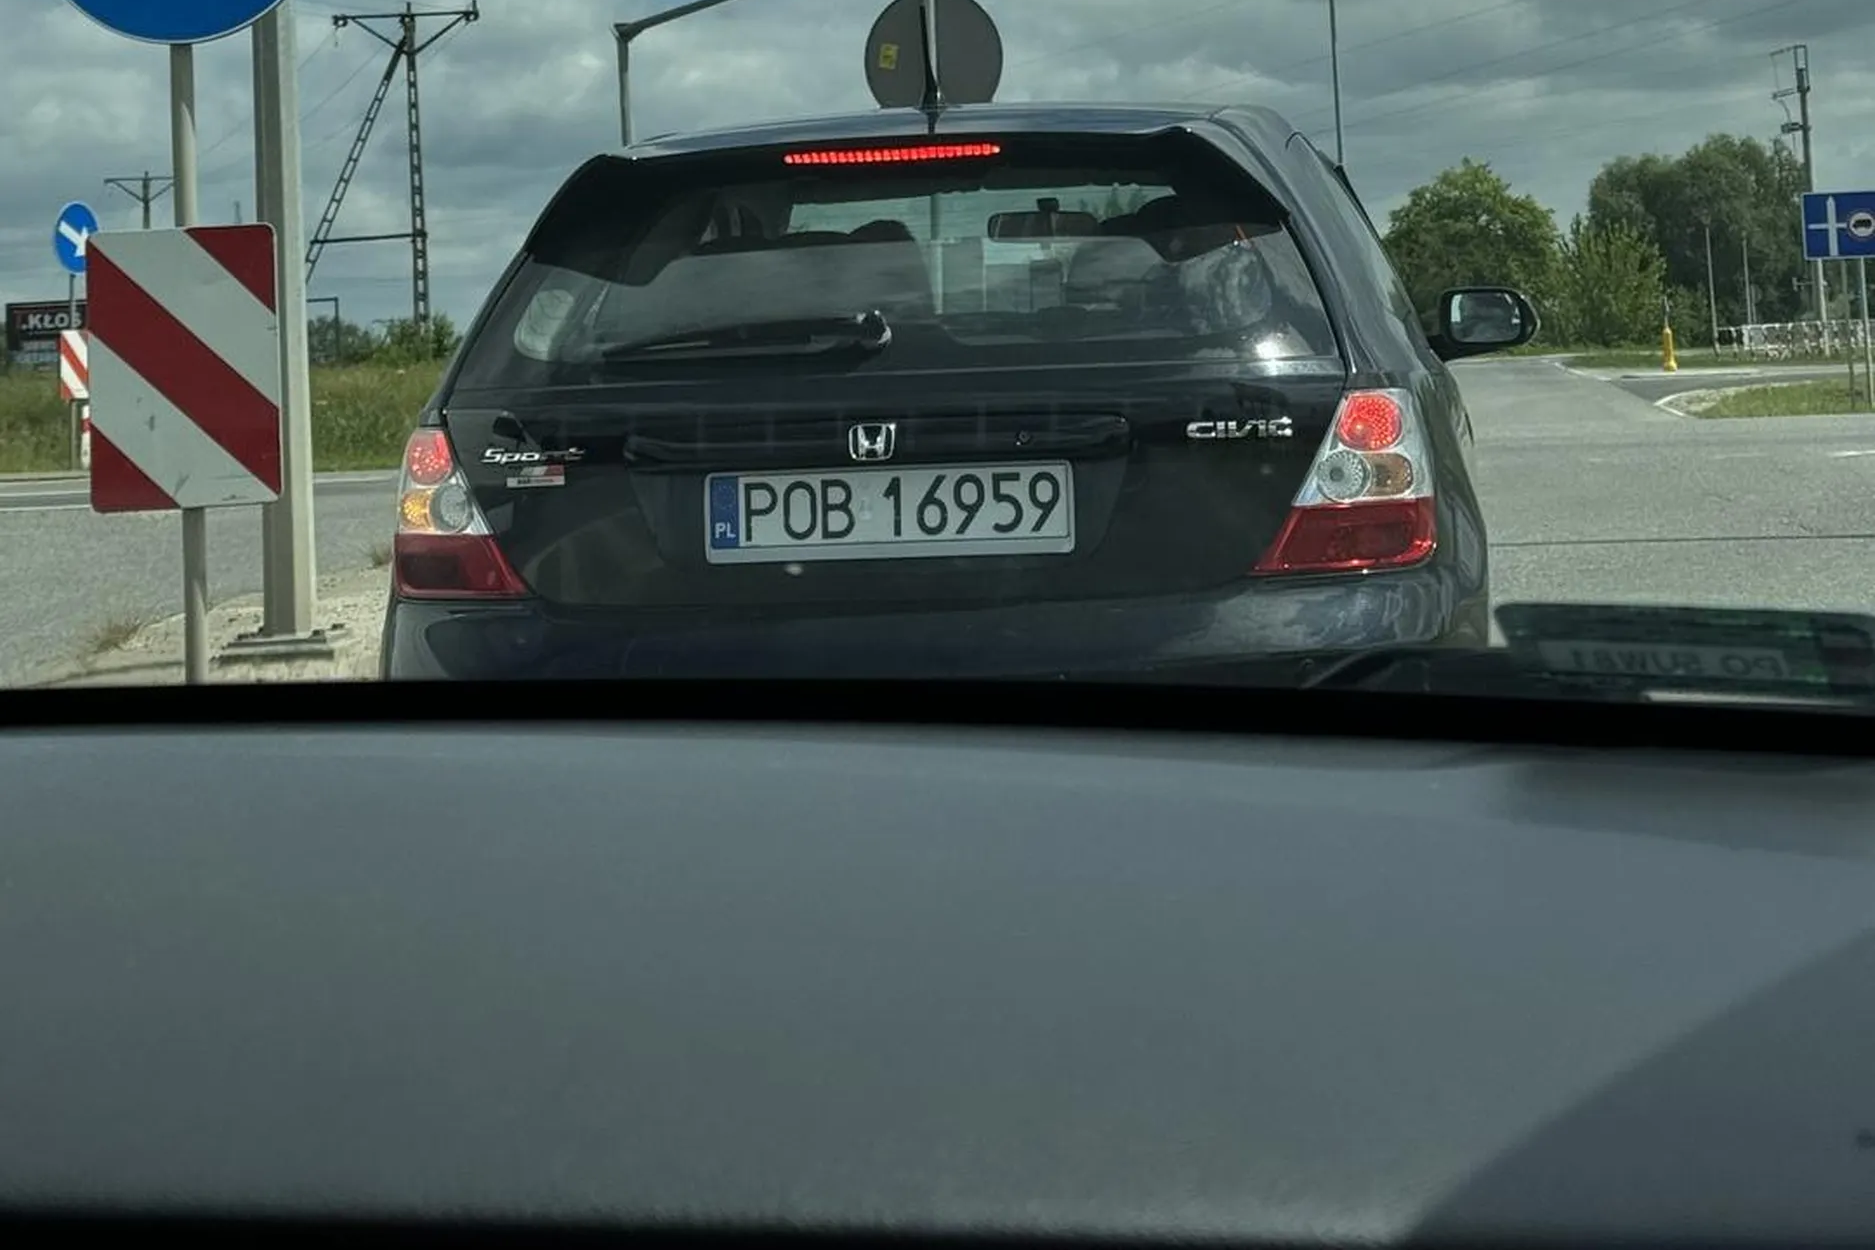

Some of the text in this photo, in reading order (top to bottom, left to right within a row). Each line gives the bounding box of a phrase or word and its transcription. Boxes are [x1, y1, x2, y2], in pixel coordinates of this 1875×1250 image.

[1186, 416, 1293, 439] CIVIC
[743, 471, 1061, 542] POB 16959
[715, 521, 737, 539] PL
